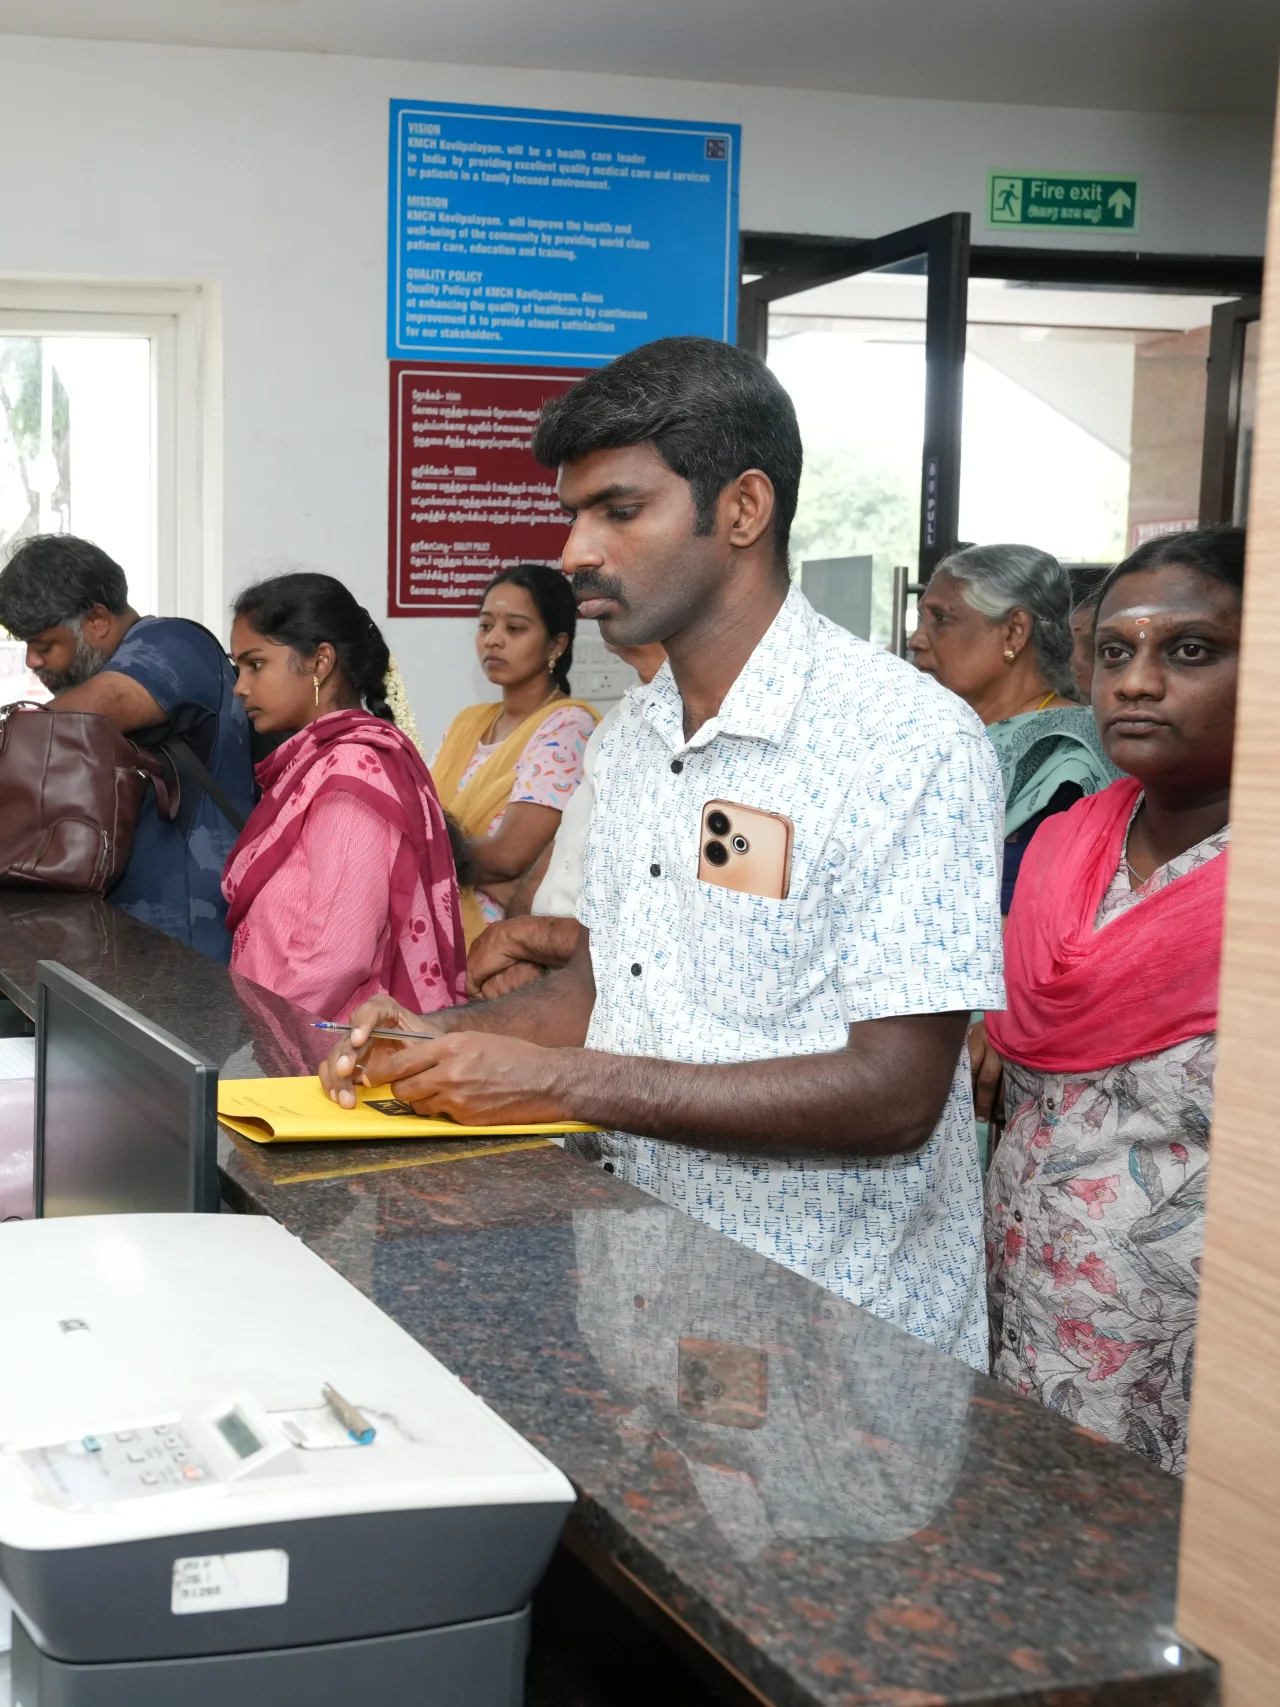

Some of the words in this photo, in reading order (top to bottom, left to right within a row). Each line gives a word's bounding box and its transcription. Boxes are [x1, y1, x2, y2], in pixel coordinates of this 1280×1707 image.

[408, 122, 440, 134] VISION
[407, 137, 436, 149] KMCH
[439, 139, 503, 156] Kovilpalayam.
[507, 144, 523, 155] will
[528, 146, 539, 156] be
[545, 149, 551, 157] a
[557, 148, 586, 159] health
[591, 152, 611, 161] care
[617, 152, 645, 164] leader
[407, 152, 416, 162] in
[422, 153, 446, 164] India
[452, 155, 462, 167] by
[468, 156, 511, 171] providing
[514, 159, 555, 172] excellent
[559, 162, 589, 176] quality
[592, 165, 628, 177] medical
[630, 169, 650, 178] care
[654, 169, 670, 180] and
[673, 170, 709, 182] services
[407, 166, 416, 177] to
[420, 167, 457, 182] patients
[461, 170, 469, 180] in
[473, 173, 478, 181] a
[481, 171, 509, 185] family
[513, 173, 548, 186] focused
[552, 176, 610, 190] environment.
[407, 195, 448, 208] MISSION
[1031, 181, 1065, 199] Fire
[1070, 184, 1102, 201] exit
[407, 210, 435, 222] KMCH
[438, 212, 502, 228] Kovilpalayam.
[508, 216, 525, 227] will
[527, 218, 563, 232] improve
[566, 220, 581, 231] the
[583, 221, 612, 233] health
[614, 223, 631, 234] and
[406, 225, 456, 240] well-being
[458, 228, 468, 238] of
[471, 229, 485, 239] the
[488, 230, 538, 245] community
[541, 233, 551, 245] by
[554, 234, 596, 248] providing
[599, 237, 623, 248] world
[626, 238, 649, 249] class
[407, 239, 439, 253] patient
[443, 244, 467, 254] care,
[469, 243, 515, 255] education
[519, 246, 535, 257] and
[538, 247, 576, 261] training.
[406, 267, 445, 279] QUALITY
[448, 270, 481, 282] POLICY
[406, 282, 439, 296] Quality
[442, 284, 470, 298] Policy
[473, 286, 482, 296] of
[485, 287, 513, 298] KMCH
[516, 288, 579, 304] Kovilpalayam.
[581, 292, 602, 303] Aims
[406, 297, 415, 307] at
[418, 297, 467, 312] enhancing
[470, 300, 484, 311] the
[488, 301, 519, 315] quality
[522, 303, 530, 313] of
[534, 304, 581, 316] healthcare
[585, 307, 595, 319] by
[598, 308, 646, 320] continuous
[406, 311, 465, 326] improvement
[469, 315, 475, 325] &
[479, 315, 488, 326] to
[491, 316, 524, 330] provide
[528, 318, 558, 329] utmost
[562, 320, 614, 332] satisfaction
[406, 326, 419, 336] for
[422, 329, 437, 337] our
[440, 328, 502, 341] stakeholders.
[927, 499, 935, 544] PULL
